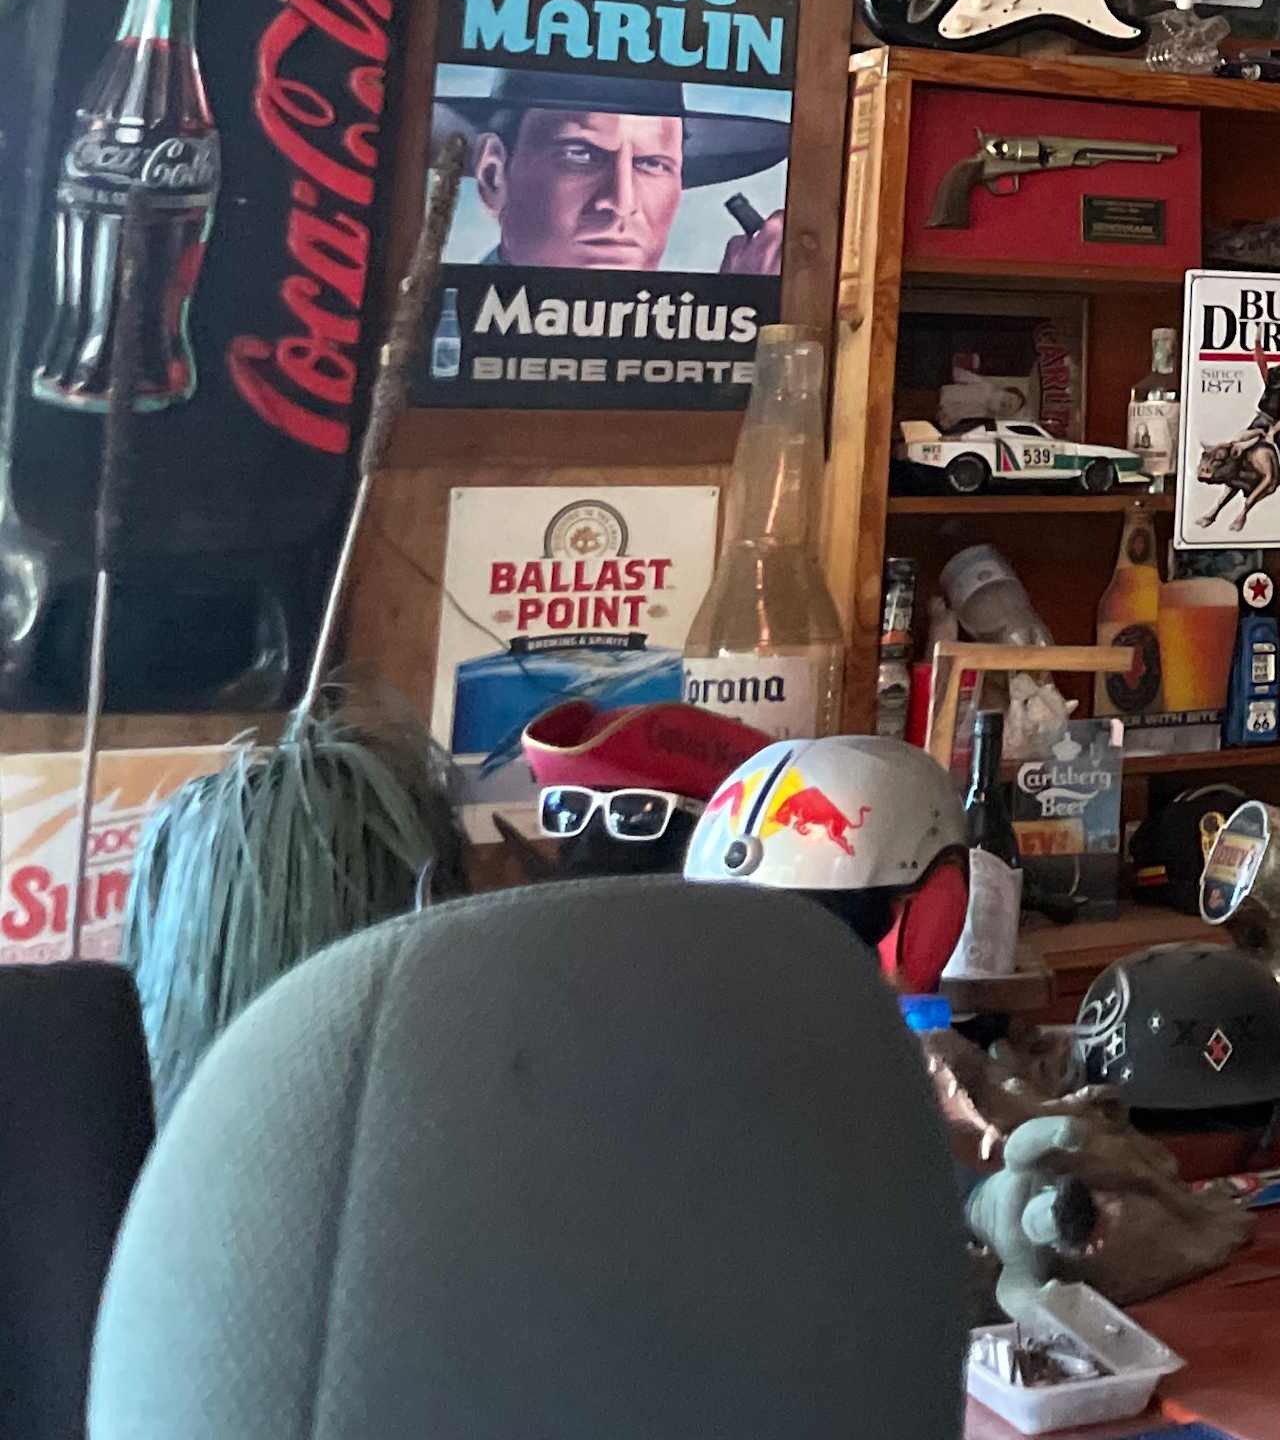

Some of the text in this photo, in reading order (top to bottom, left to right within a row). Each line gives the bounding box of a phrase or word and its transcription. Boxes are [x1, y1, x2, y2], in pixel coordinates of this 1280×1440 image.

[474, 284, 758, 344] Mauritius
[472, 357, 756, 385] BIERE FORTE
[1201, 379, 1244, 394] 1871
[1024, 448, 1051, 466] 539
[489, 558, 672, 595] BALLAST
[517, 595, 647, 631] POINT
[529, 636, 576, 649] BREWING
[589, 635, 629, 647] SPIRITS
[1017, 762, 1112, 794] Carlsberg
[1041, 796, 1088, 817] Beer
